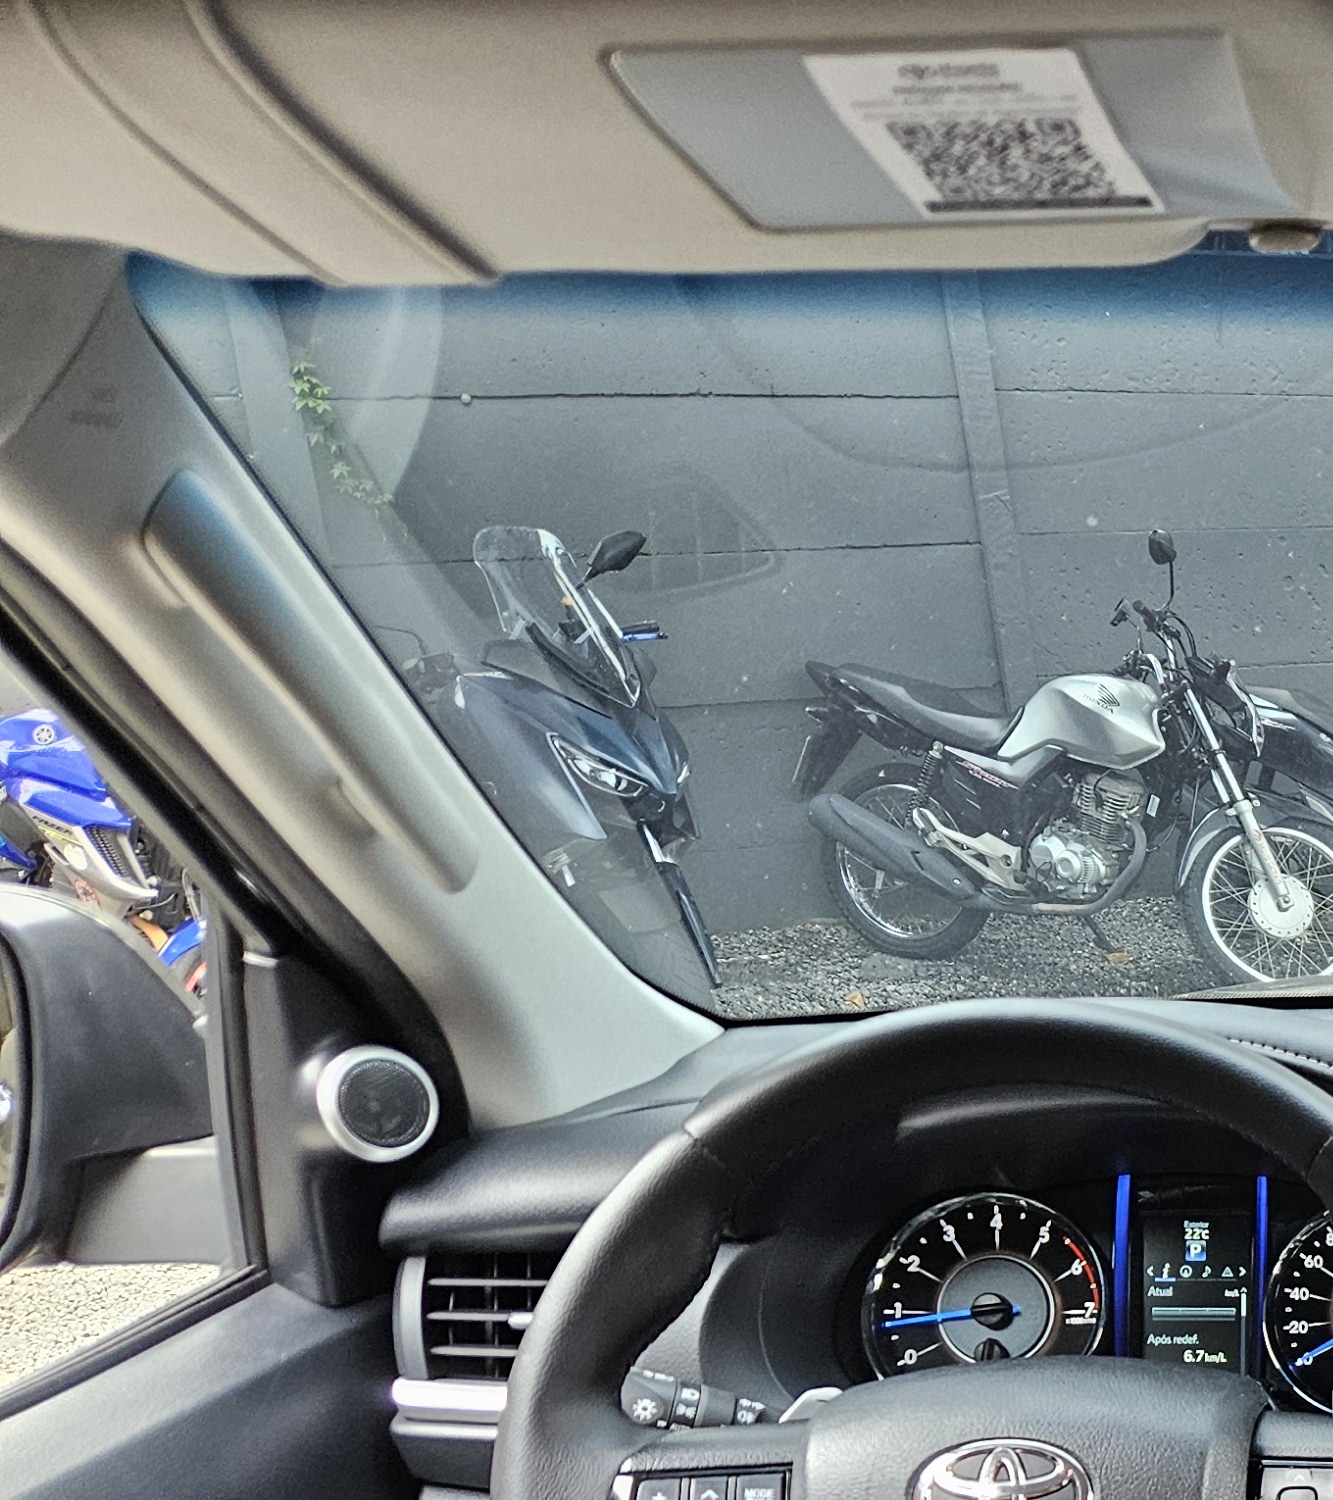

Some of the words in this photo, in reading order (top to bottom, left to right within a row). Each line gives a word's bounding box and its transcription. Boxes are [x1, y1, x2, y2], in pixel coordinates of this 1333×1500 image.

[990, 1212, 1002, 1230] 4
[943, 1224, 956, 1242] 3
[1039, 1226, 1051, 1243] 5
[1189, 1243, 1202, 1258] P
[907, 1255, 920, 1272] 2
[1070, 1258, 1083, 1276] 6
[1304, 1255, 1324, 1269] 60
[1147, 1286, 1173, 1297] Atual
[1289, 1287, 1310, 1301] 40
[893, 1302, 902, 1318] 1
[1083, 1301, 1096, 1319] 7
[1289, 1320, 1309, 1334] 20
[1147, 1333, 1172, 1346] Após
[1173, 1333, 1199, 1345] redef.
[904, 1349, 917, 1365] 0
[1183, 1349, 1205, 1363] 6.7
